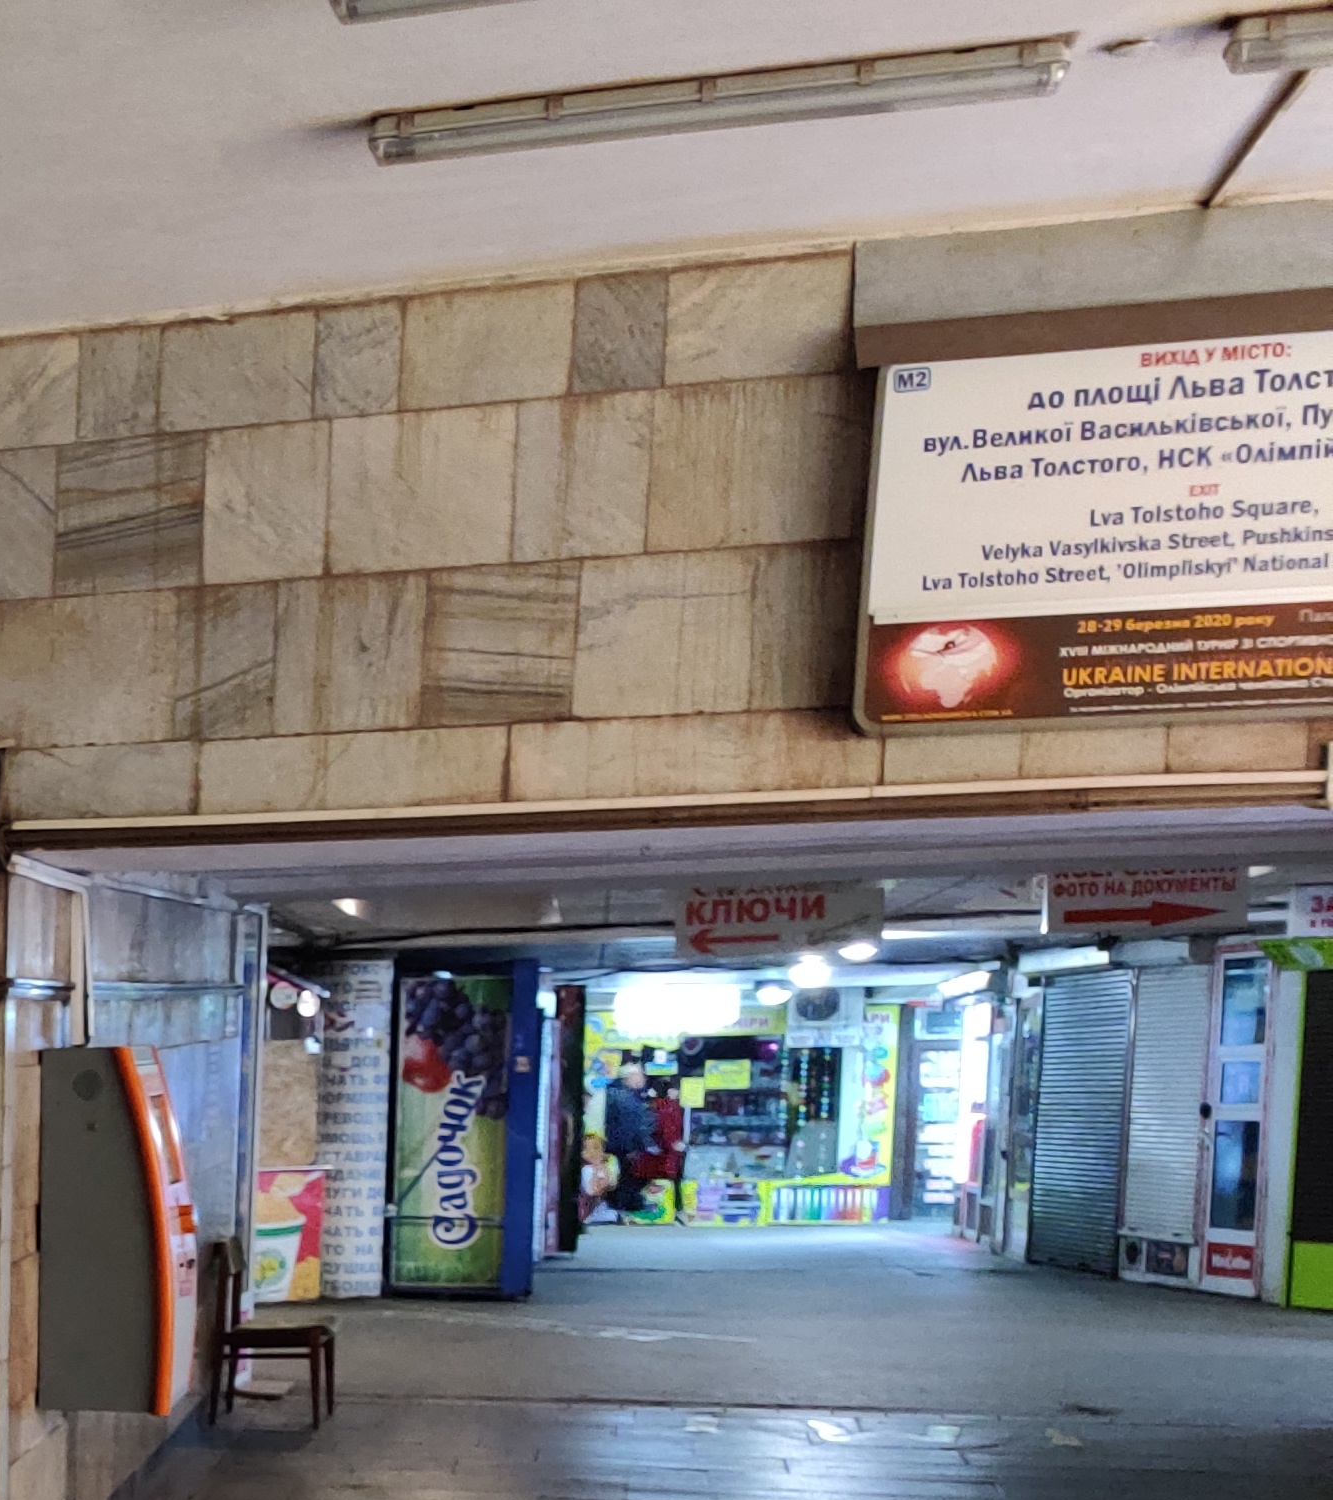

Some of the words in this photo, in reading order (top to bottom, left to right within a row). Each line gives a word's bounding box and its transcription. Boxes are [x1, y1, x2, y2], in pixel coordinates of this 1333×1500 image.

[1140, 352, 1200, 368] ВИХІД
[1205, 348, 1216, 363] У
[1221, 342, 1293, 361] МІСТО:
[1027, 390, 1065, 410] до
[1074, 376, 1161, 405] площі
[1168, 375, 1245, 400] Льва
[1080, 405, 1292, 441] Васильківської,
[961, 462, 1023, 483] Льва
[1031, 455, 1149, 478] Толстого,
[1158, 445, 1214, 469] НСК
[1189, 483, 1220, 497] EXIT
[1090, 508, 1124, 527] Lva
[1131, 501, 1224, 524] Tolstoho
[1231, 497, 1320, 521] Square,
[982, 542, 1043, 563] Velyka
[1049, 532, 1161, 558] Vasylkivska
[922, 575, 952, 591] Lva
[958, 568, 1039, 589] Tolstoho
[1045, 564, 1111, 583] Street,
[1243, 553, 1329, 574] National
[1062, 663, 1167, 687] UKRAINE
[1053, 880, 1100, 897] ФОТО
[1104, 878, 1126, 895] НА
[1131, 875, 1237, 898] ДОКУМЕНТЫ
[685, 893, 826, 926] КЛЮЧИ
[432, 1073, 484, 1246] Садочок
